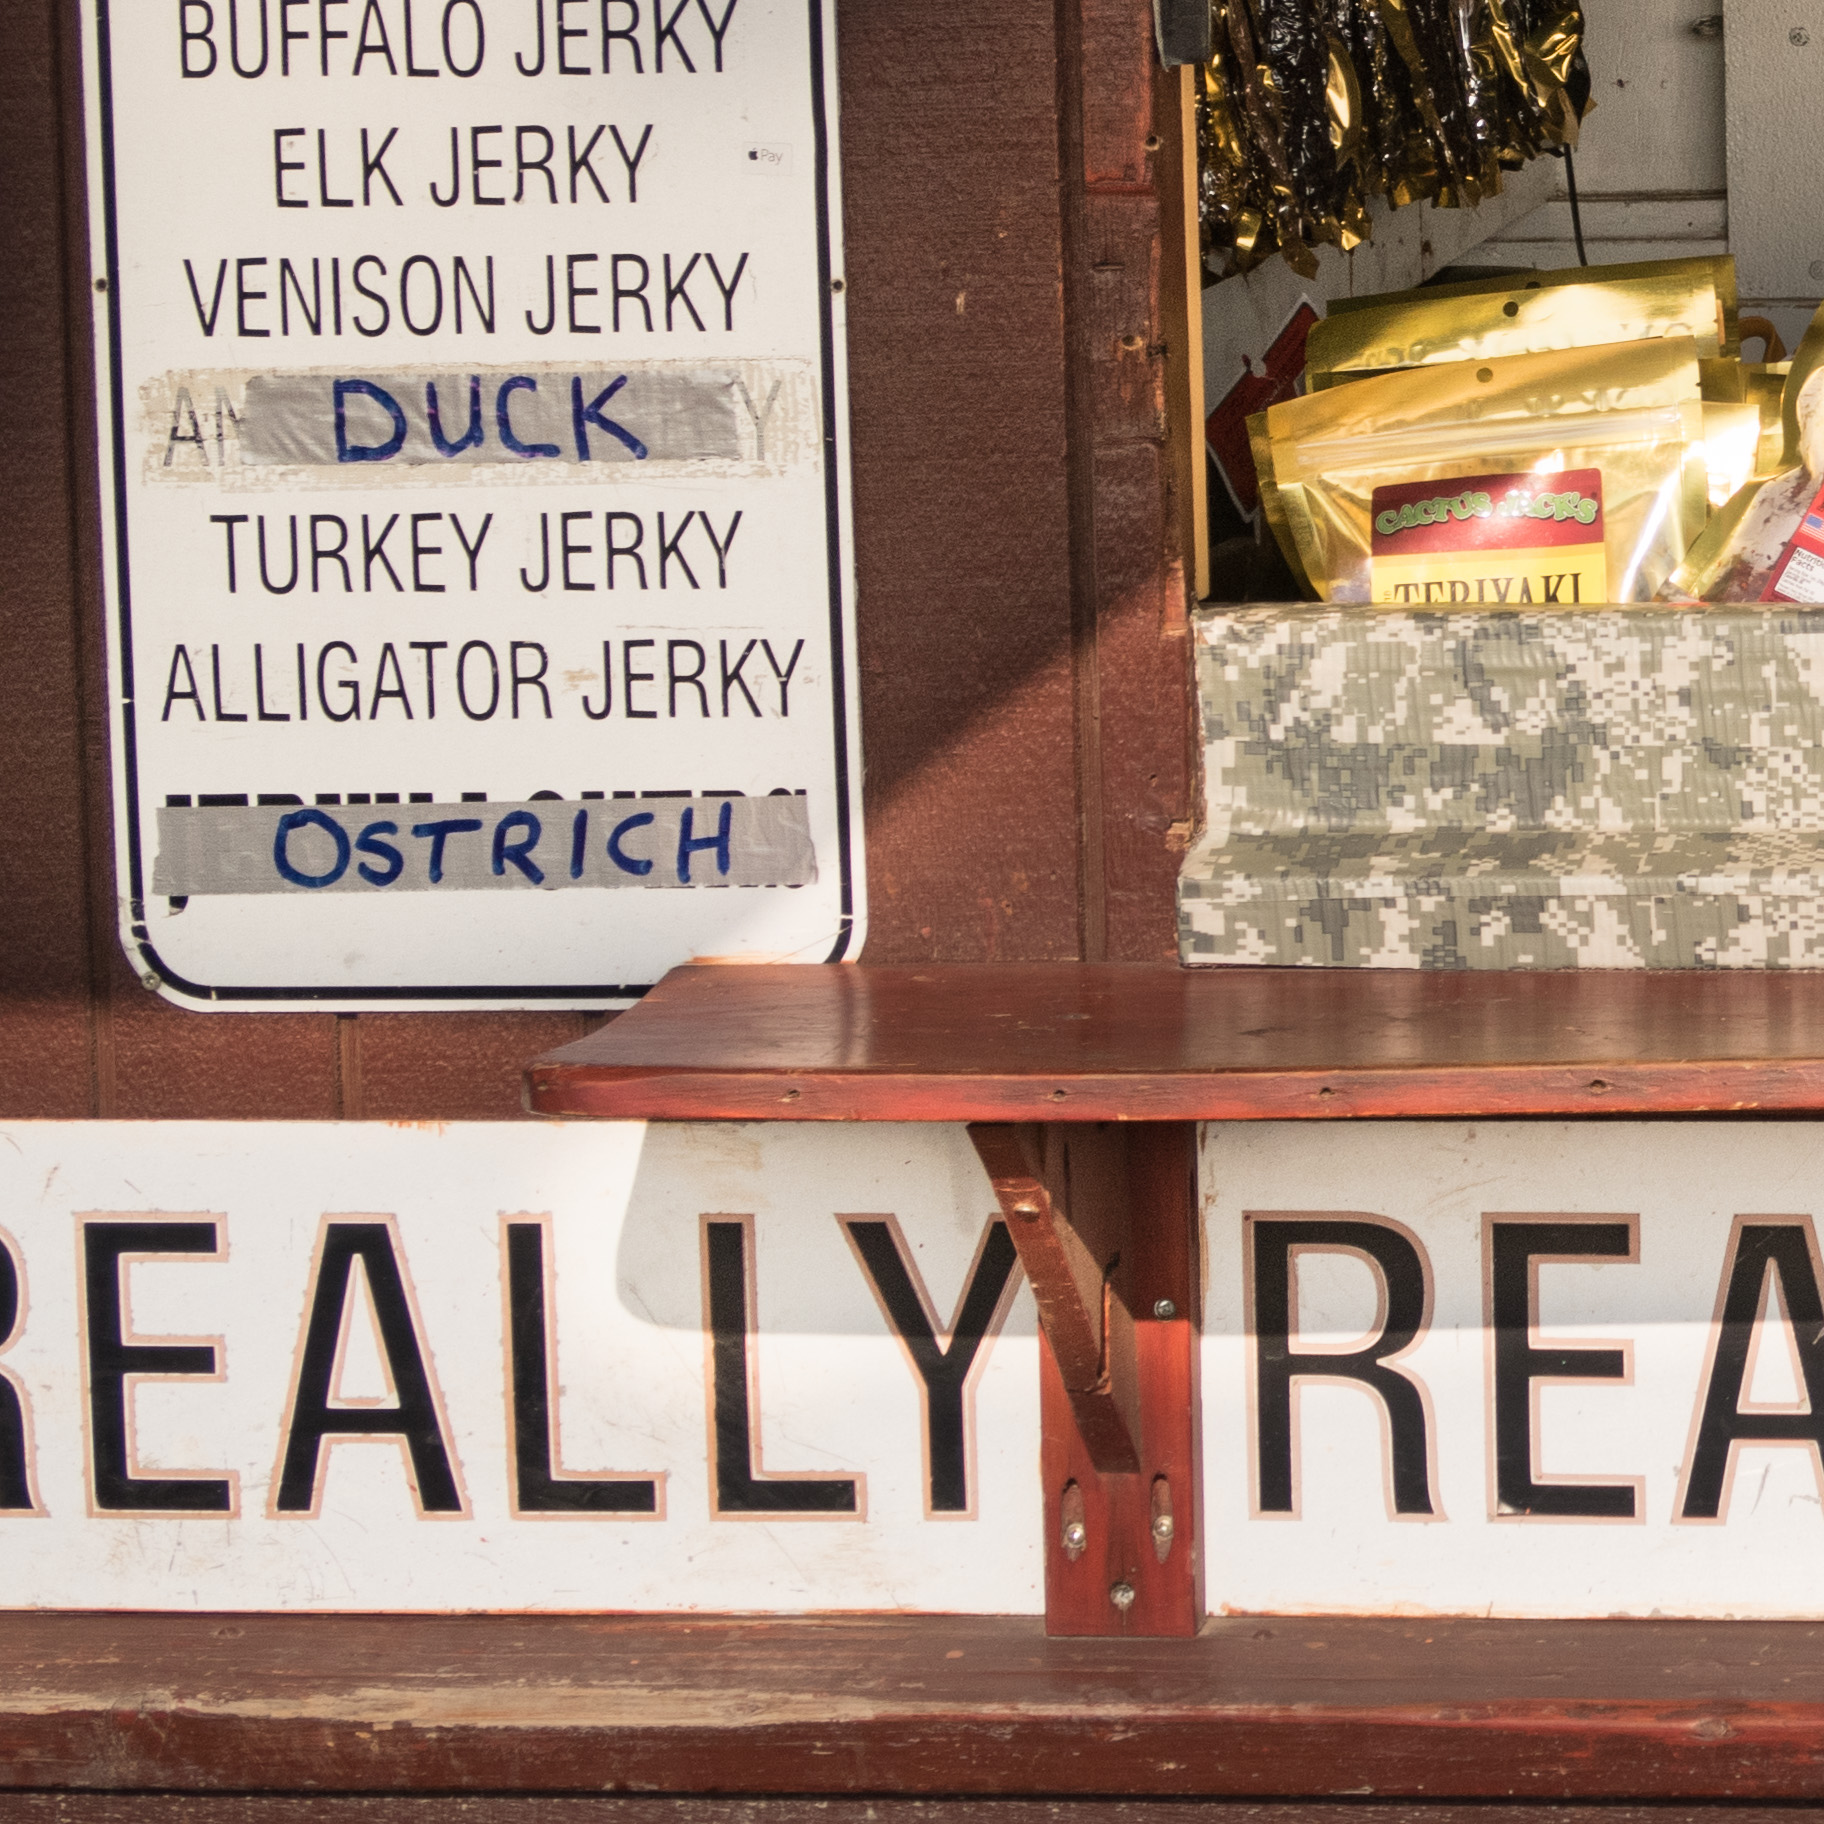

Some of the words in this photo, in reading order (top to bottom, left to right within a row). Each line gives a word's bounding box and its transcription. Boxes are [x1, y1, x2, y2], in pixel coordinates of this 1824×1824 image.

[273, 125, 405, 210] ELK
[429, 122, 654, 208] JERKY
[760, 149, 784, 166] Pay
[182, 252, 498, 339] VENISON
[525, 250, 751, 336] JERKY
[332, 374, 651, 466] DUCK
[209, 511, 494, 595] TURKEY
[519, 509, 744, 594] JERKY
[1375, 491, 1493, 534] CACTUS
[1791, 556, 1815, 572] Facts
[160, 639, 552, 724] ALLIGATOR
[580, 638, 806, 721] JERKY
[273, 799, 733, 888] OSTRICH
[0, 1210, 1035, 1521] EALLY
